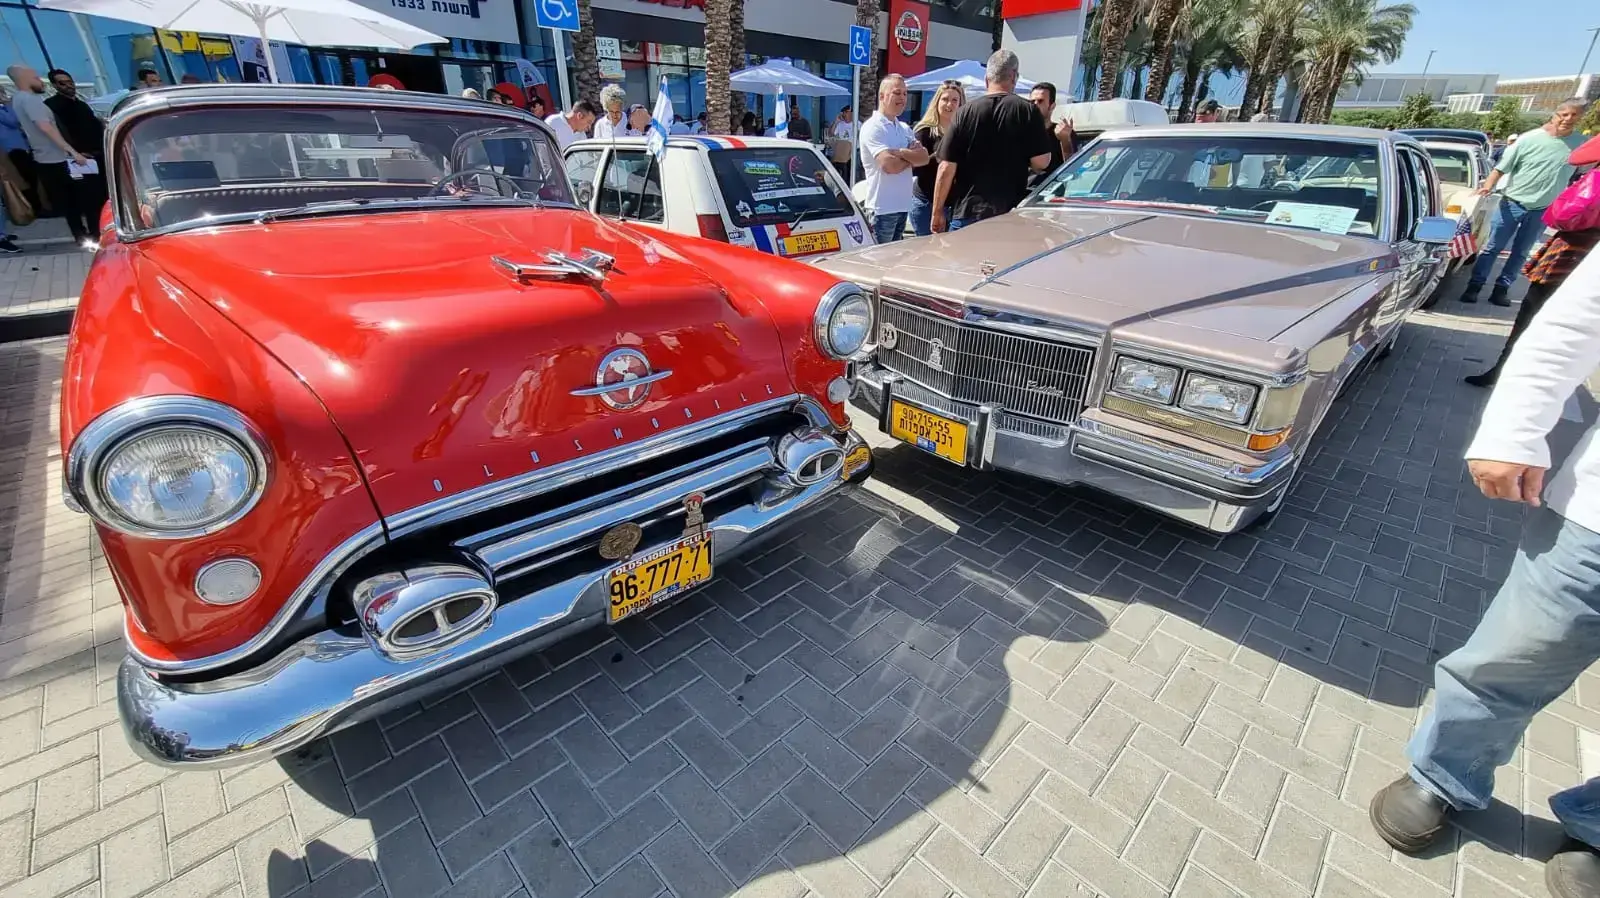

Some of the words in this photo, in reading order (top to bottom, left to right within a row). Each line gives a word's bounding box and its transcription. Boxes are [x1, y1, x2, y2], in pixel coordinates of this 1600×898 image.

[432, 0, 471, 15] משנת
[433, 384, 773, 493] OLDSMOBILE
[899, 418, 931, 439] אספנות
[935, 431, 953, 448] רכב
[615, 544, 678, 576] OLDSMOBILE
